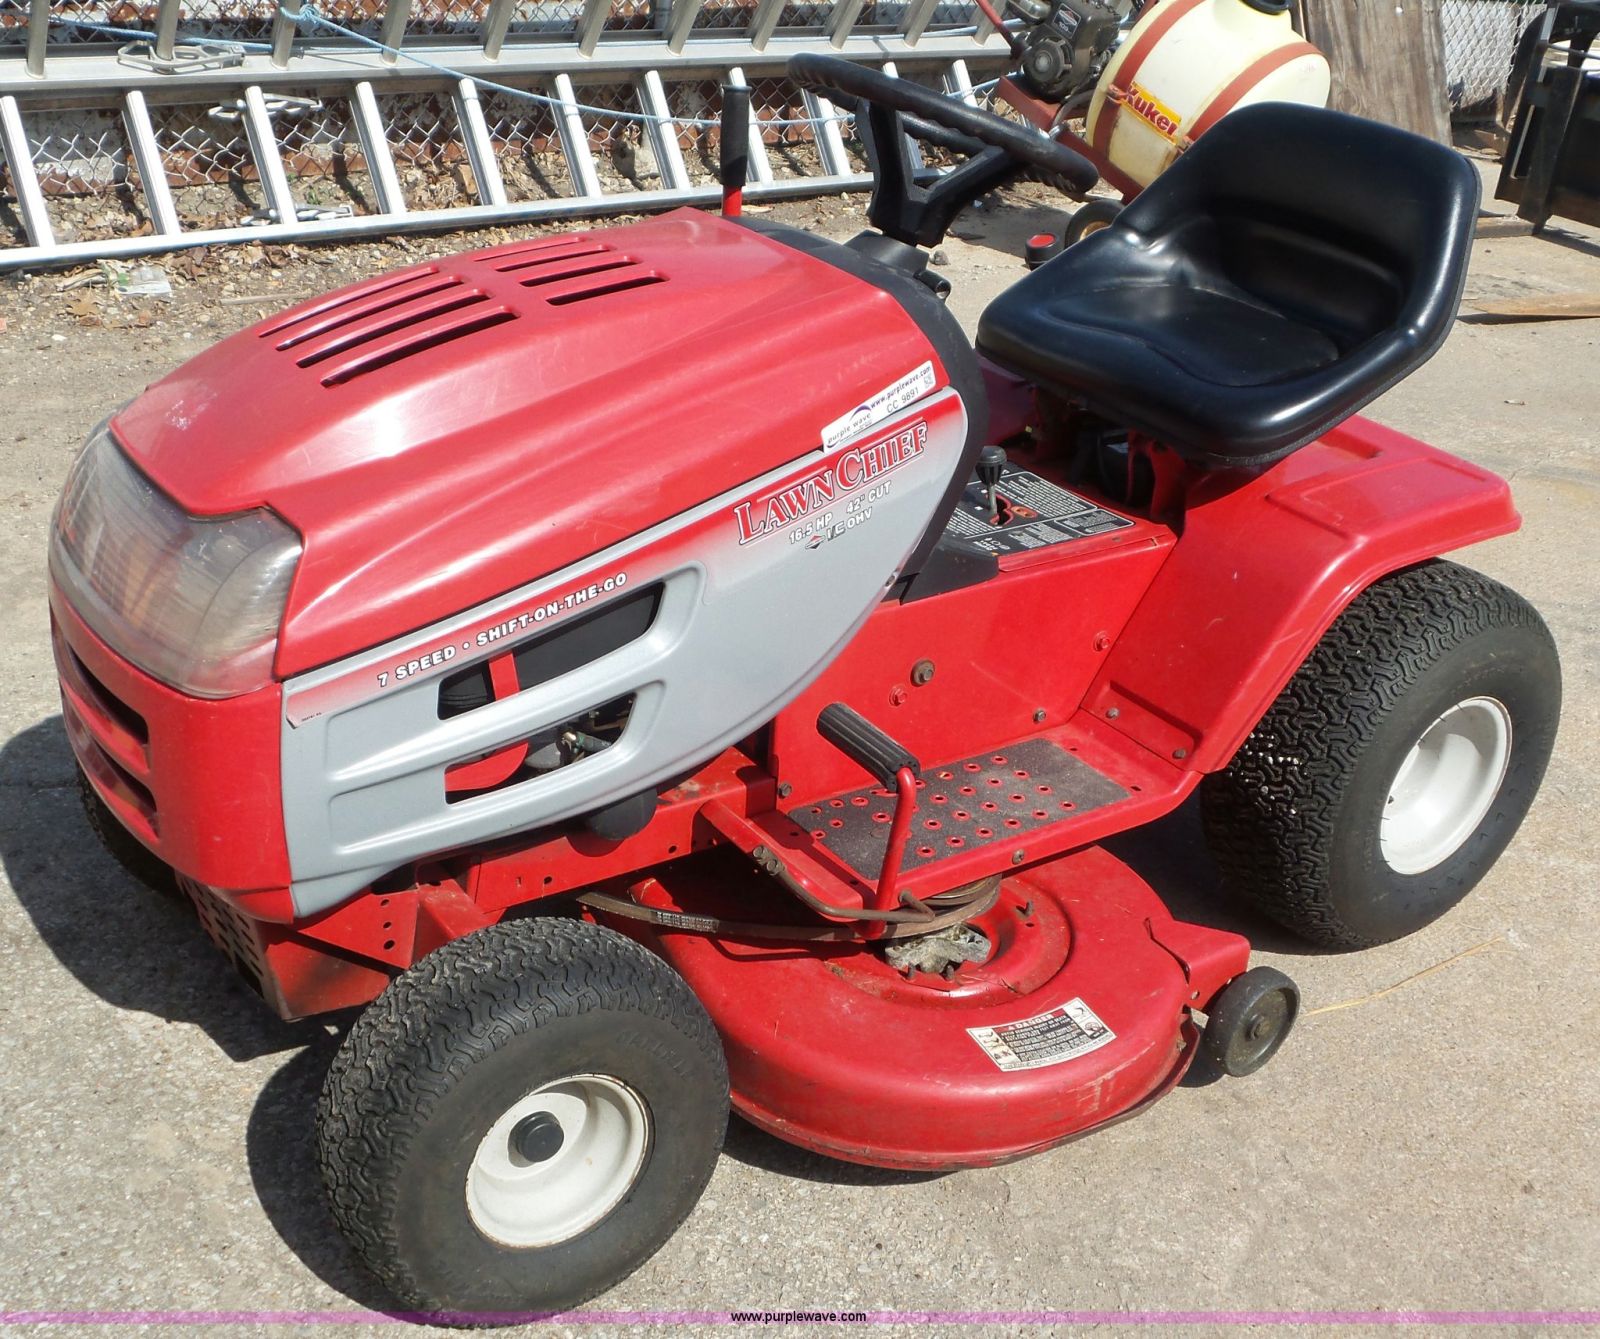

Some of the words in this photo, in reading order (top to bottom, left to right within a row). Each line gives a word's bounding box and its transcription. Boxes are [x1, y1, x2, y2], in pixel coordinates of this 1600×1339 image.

[870, 365, 931, 409] www.purplewave.com
[886, 400, 899, 414] CC
[901, 386, 919, 404] 9891
[827, 423, 851, 444] purple
[853, 412, 872, 428] wave
[733, 469, 835, 546] LAWN
[835, 420, 929, 491] CHIEF
[788, 522, 813, 545] 16.5
[815, 512, 834, 532] HP
[846, 494, 865, 514] 42"
[868, 480, 891, 503] CUT
[847, 506, 873, 529] OHV
[377, 671, 389, 688] 7
[394, 644, 457, 681] SPEED
[475, 571, 628, 647] SHIFT-ON-THE-GO
[1014, 1014, 1055, 1029] DANGER
